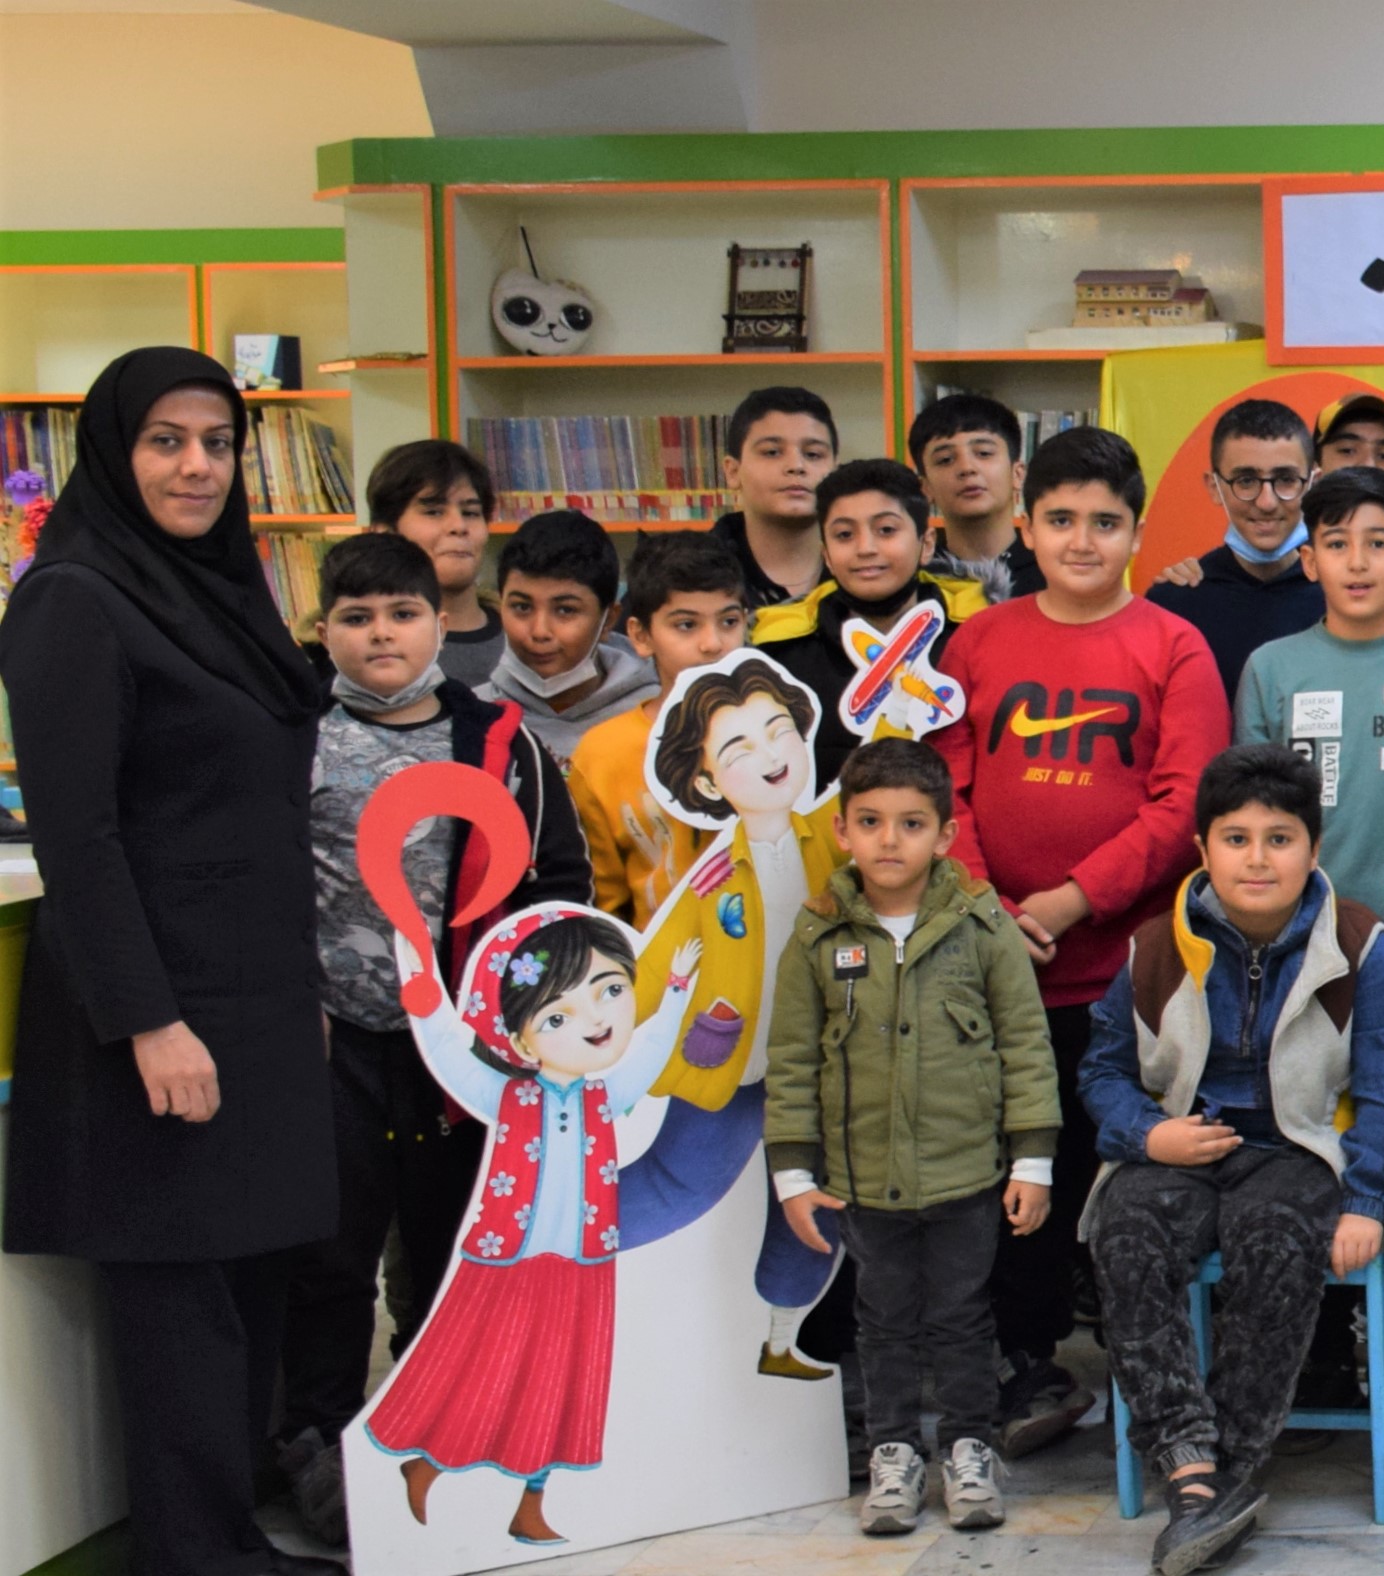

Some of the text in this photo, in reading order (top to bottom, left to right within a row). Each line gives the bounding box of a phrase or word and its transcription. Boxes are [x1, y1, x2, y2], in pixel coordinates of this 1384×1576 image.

[987, 681, 1141, 768] AIR
[1022, 767, 1052, 783] JUST
[1055, 770, 1075, 785] DO
